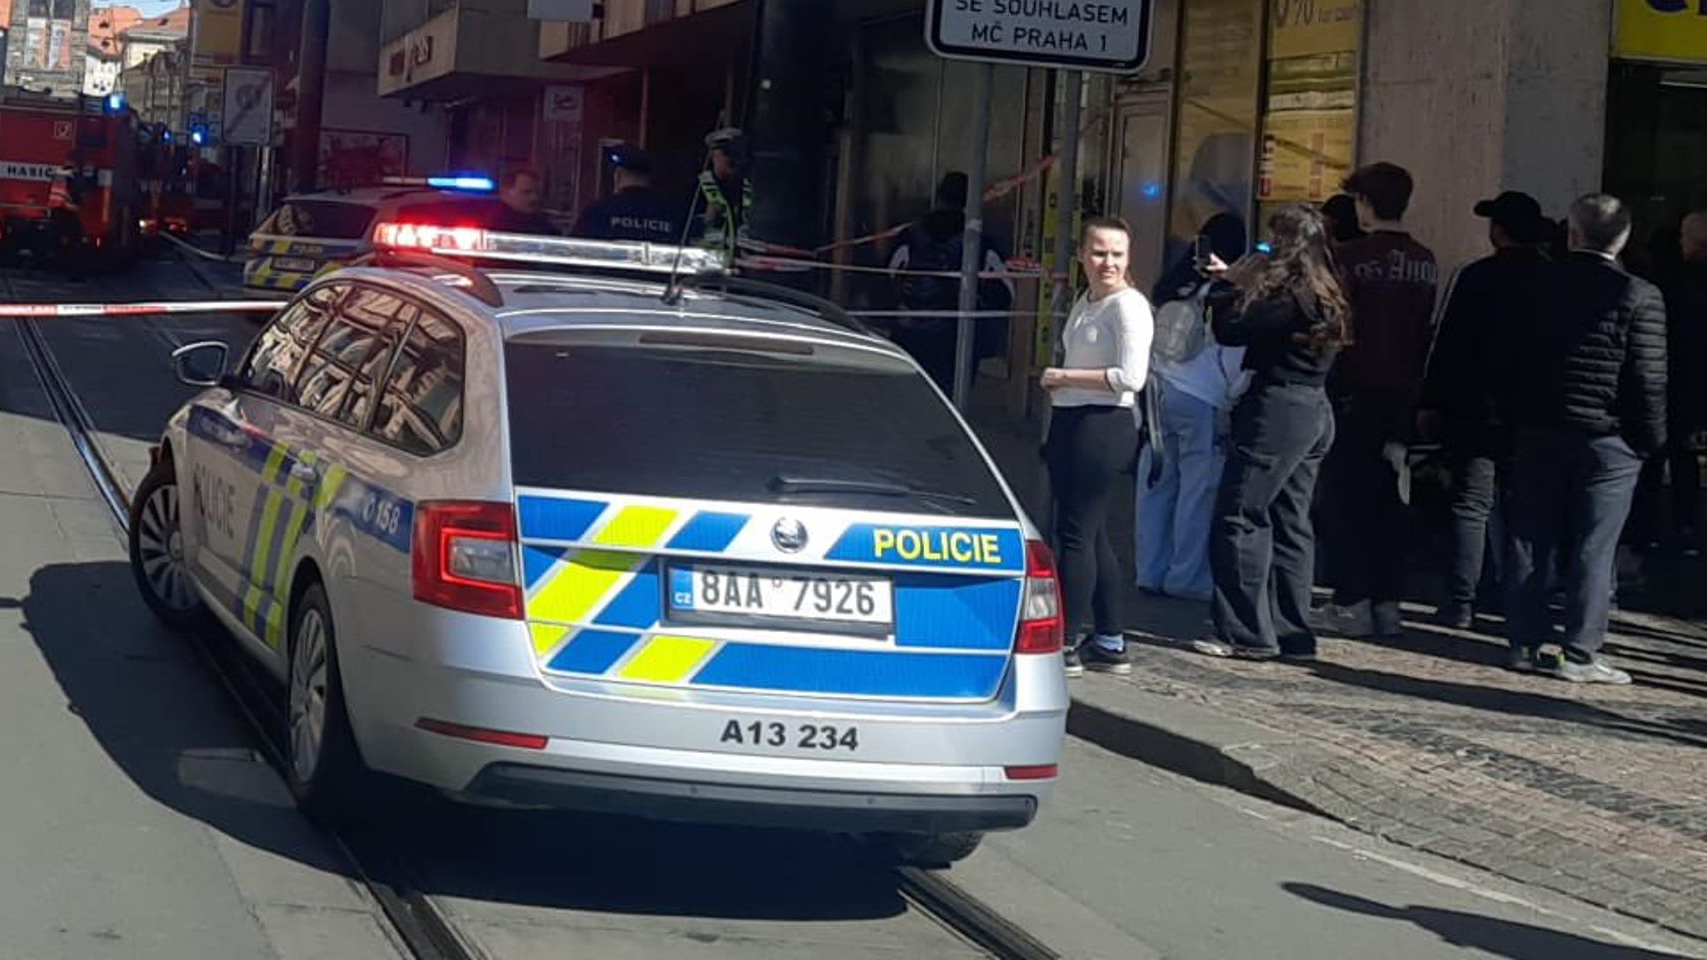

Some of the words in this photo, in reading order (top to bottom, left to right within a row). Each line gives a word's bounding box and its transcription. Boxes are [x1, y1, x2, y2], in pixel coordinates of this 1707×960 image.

[971, 20, 1002, 44] MČ
[1013, 27, 1089, 52] PRAHA
[1099, 34, 1108, 52] 1
[375, 496, 401, 534] 158
[873, 528, 1001, 563] POLICIE
[675, 593, 692, 605] CZ
[700, 570, 763, 609] 8AA
[793, 577, 875, 616] 7926
[720, 719, 786, 747] A13
[797, 724, 858, 751] 234
